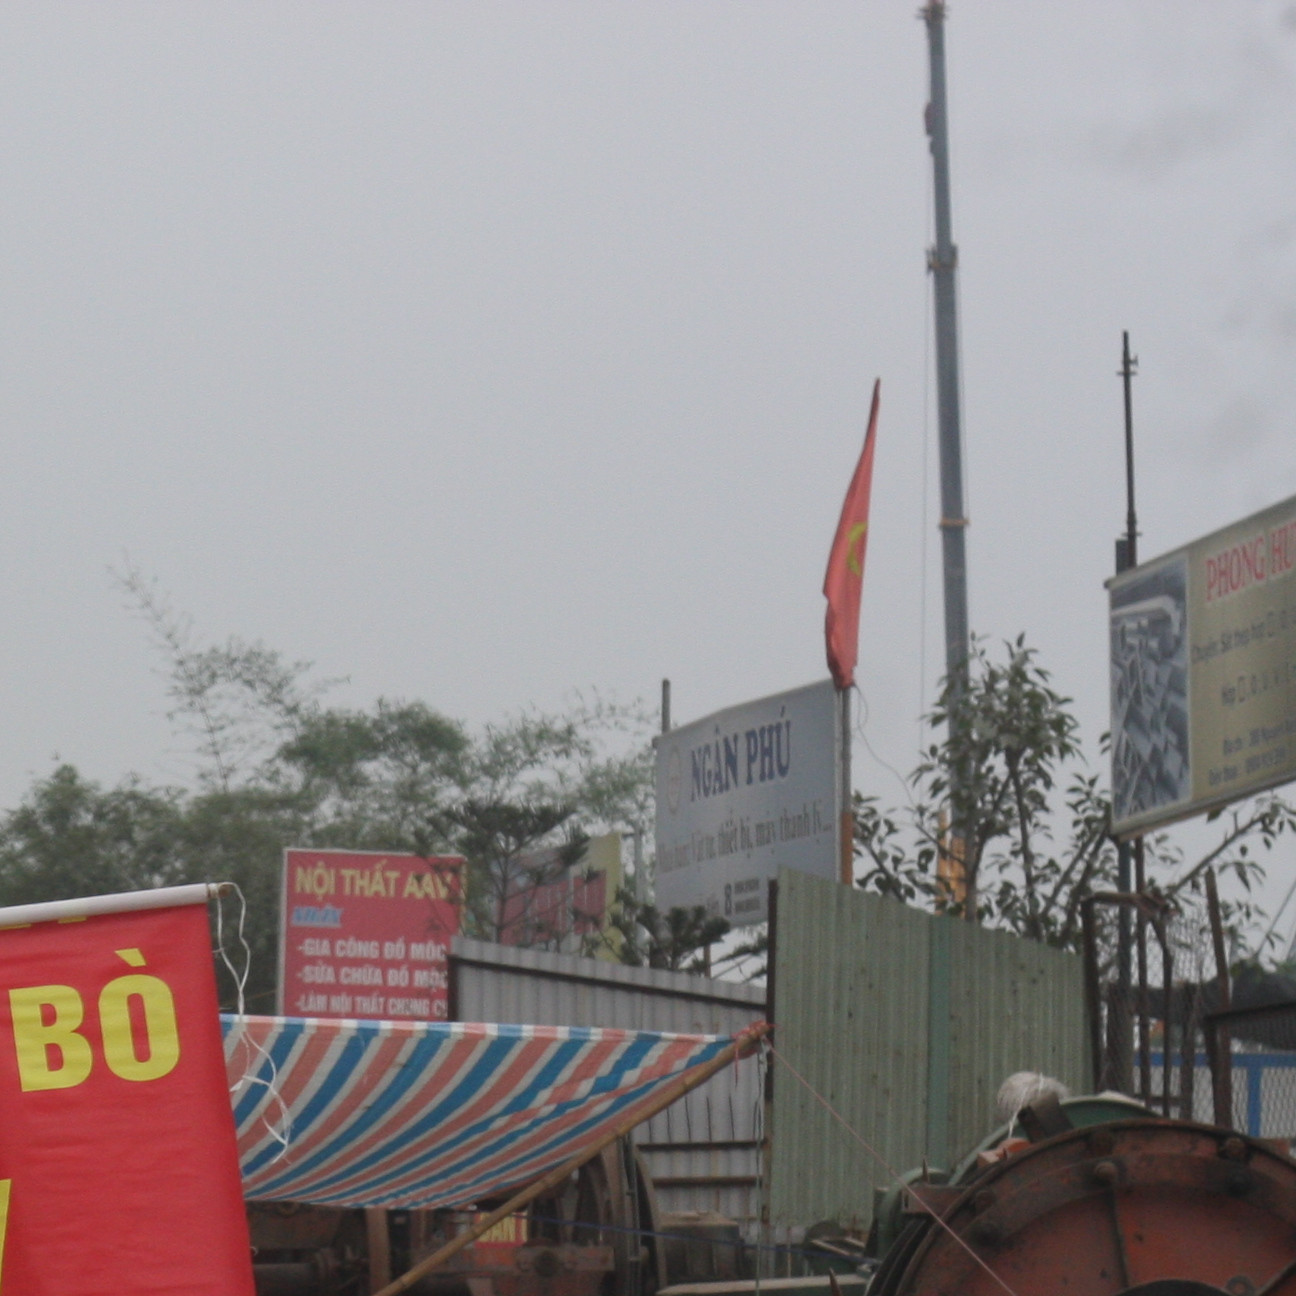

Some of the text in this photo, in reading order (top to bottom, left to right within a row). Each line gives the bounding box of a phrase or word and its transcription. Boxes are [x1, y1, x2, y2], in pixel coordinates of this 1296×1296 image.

[691, 706, 791, 801] NGÂN PHÚ
[295, 861, 335, 901] NỘI
[341, 860, 401, 898] THẤT
[8, 948, 181, 1093] BÒ
